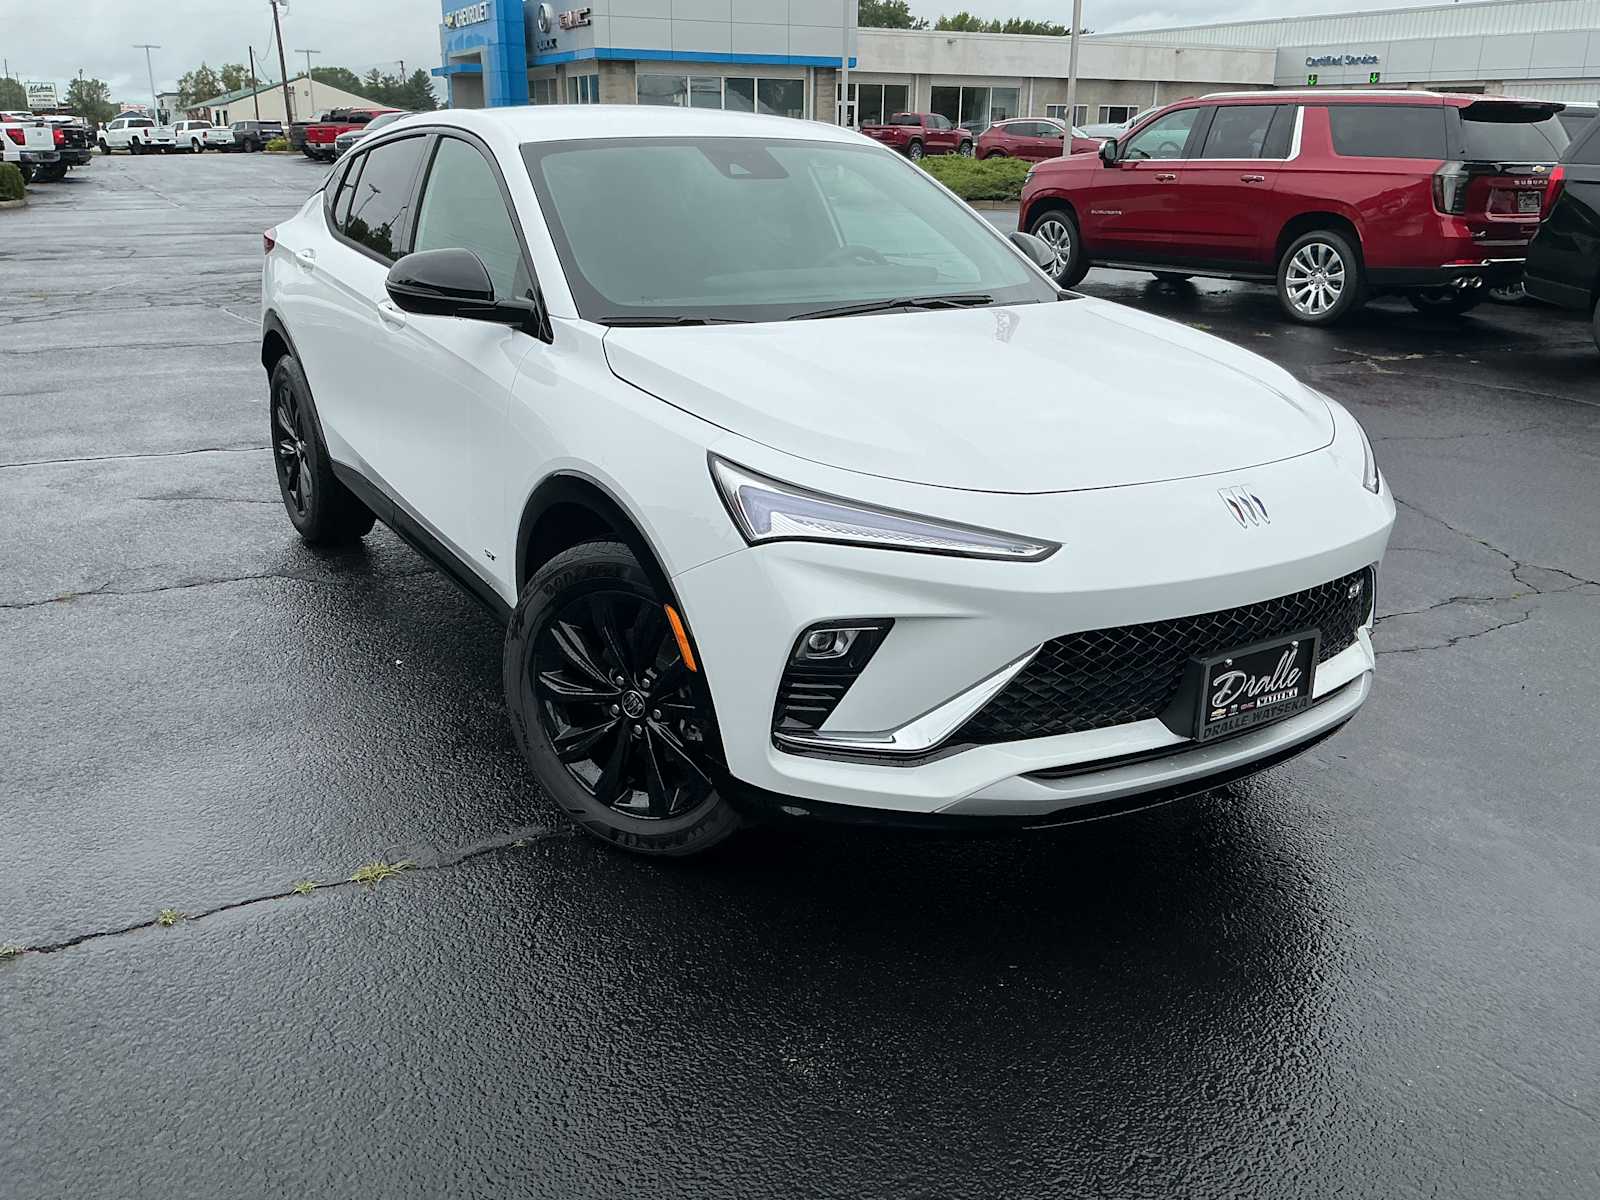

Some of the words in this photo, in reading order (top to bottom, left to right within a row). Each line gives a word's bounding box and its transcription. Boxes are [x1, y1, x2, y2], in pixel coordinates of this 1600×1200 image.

[455, 1, 488, 27] CHEVROLET
[560, 8, 591, 29] GMC
[1306, 56, 1343, 67] Certified
[1345, 54, 1378, 66] Service
[1212, 647, 1302, 707] Dralle
[1258, 688, 1298, 706] WATSEKA
[1203, 714, 1249, 738] DRALLE
[1253, 696, 1307, 722] WATSEKA
